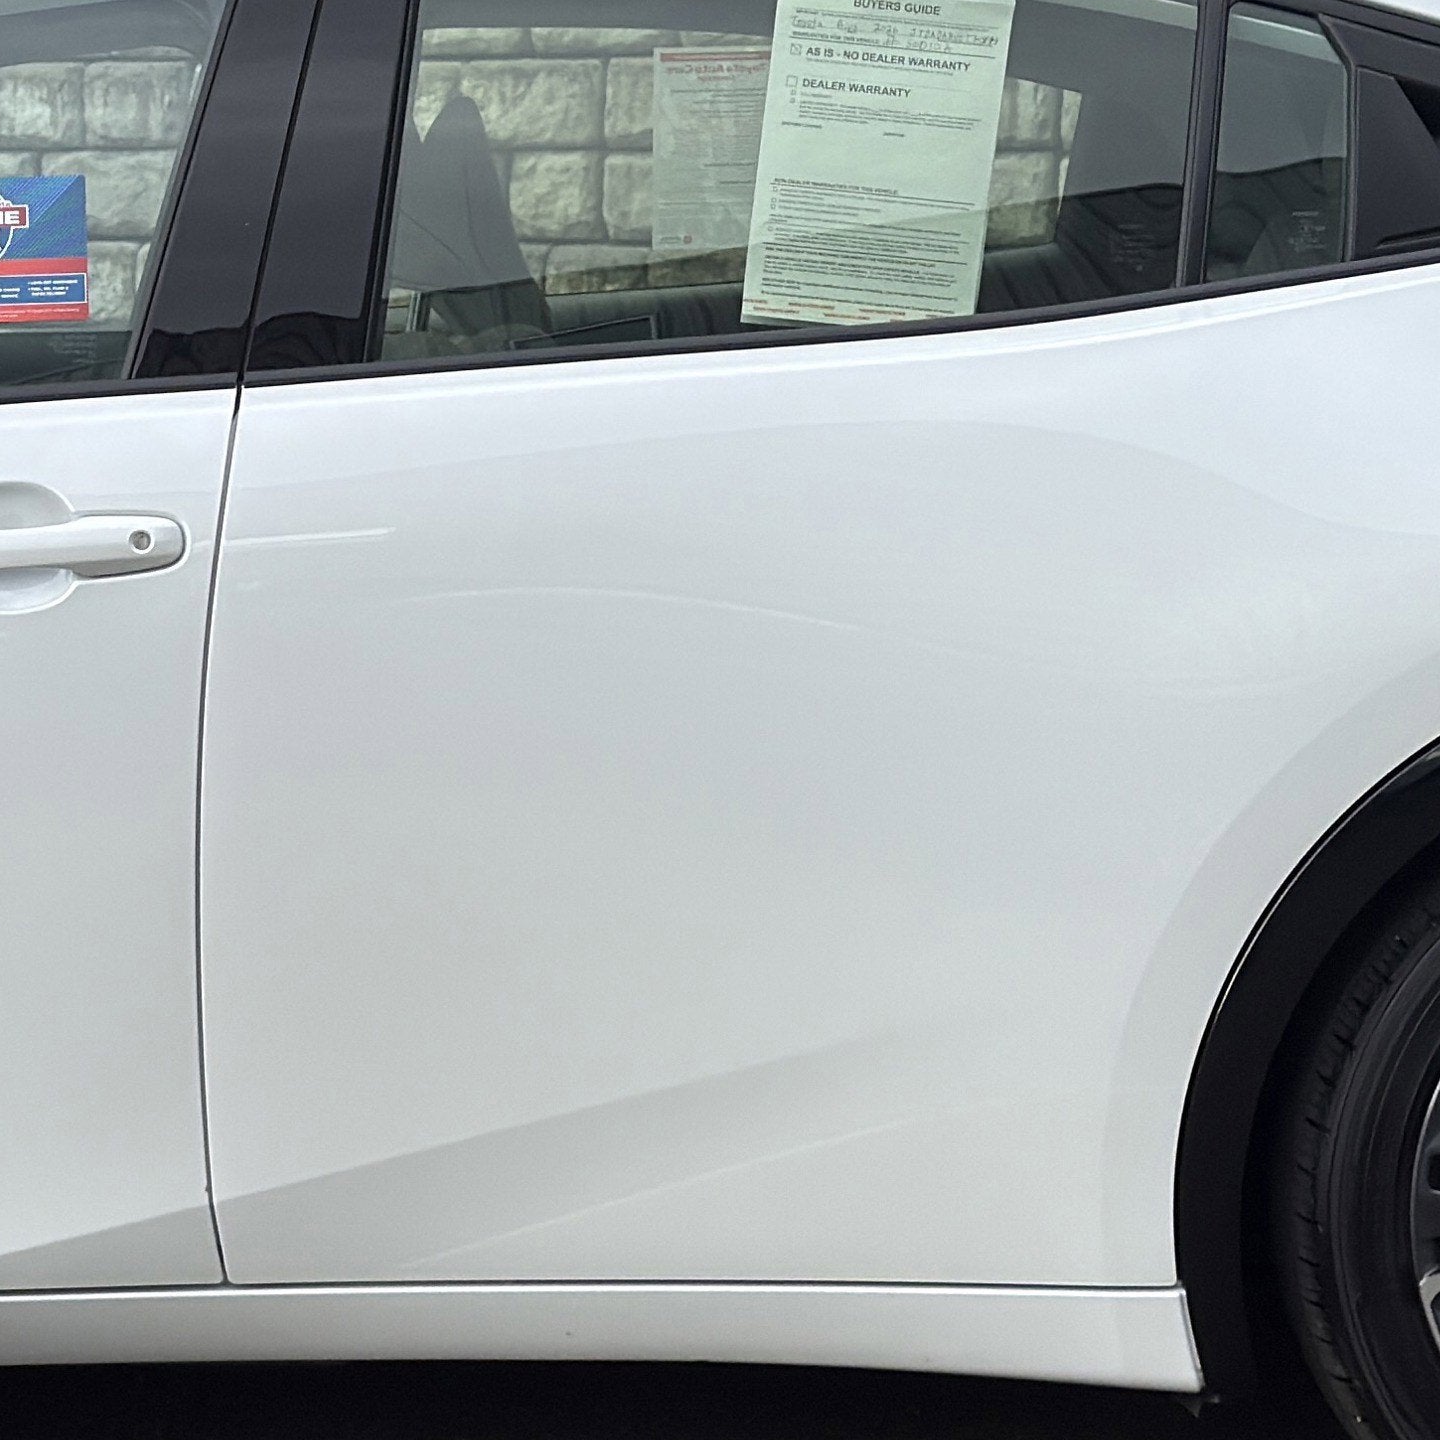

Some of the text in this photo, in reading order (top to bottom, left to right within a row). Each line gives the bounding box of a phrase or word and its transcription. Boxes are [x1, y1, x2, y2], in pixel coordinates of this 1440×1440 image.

[904, 2, 941, 16] GUIDE
[806, 47, 820, 57] AS
[824, 48, 834, 58] IS
[844, 50, 859, 60] NO
[862, 52, 905, 66] DEALER
[908, 56, 970, 71] WARRANTY
[802, 78, 845, 91] DEALER
[849, 83, 911, 98] WARRANTY
